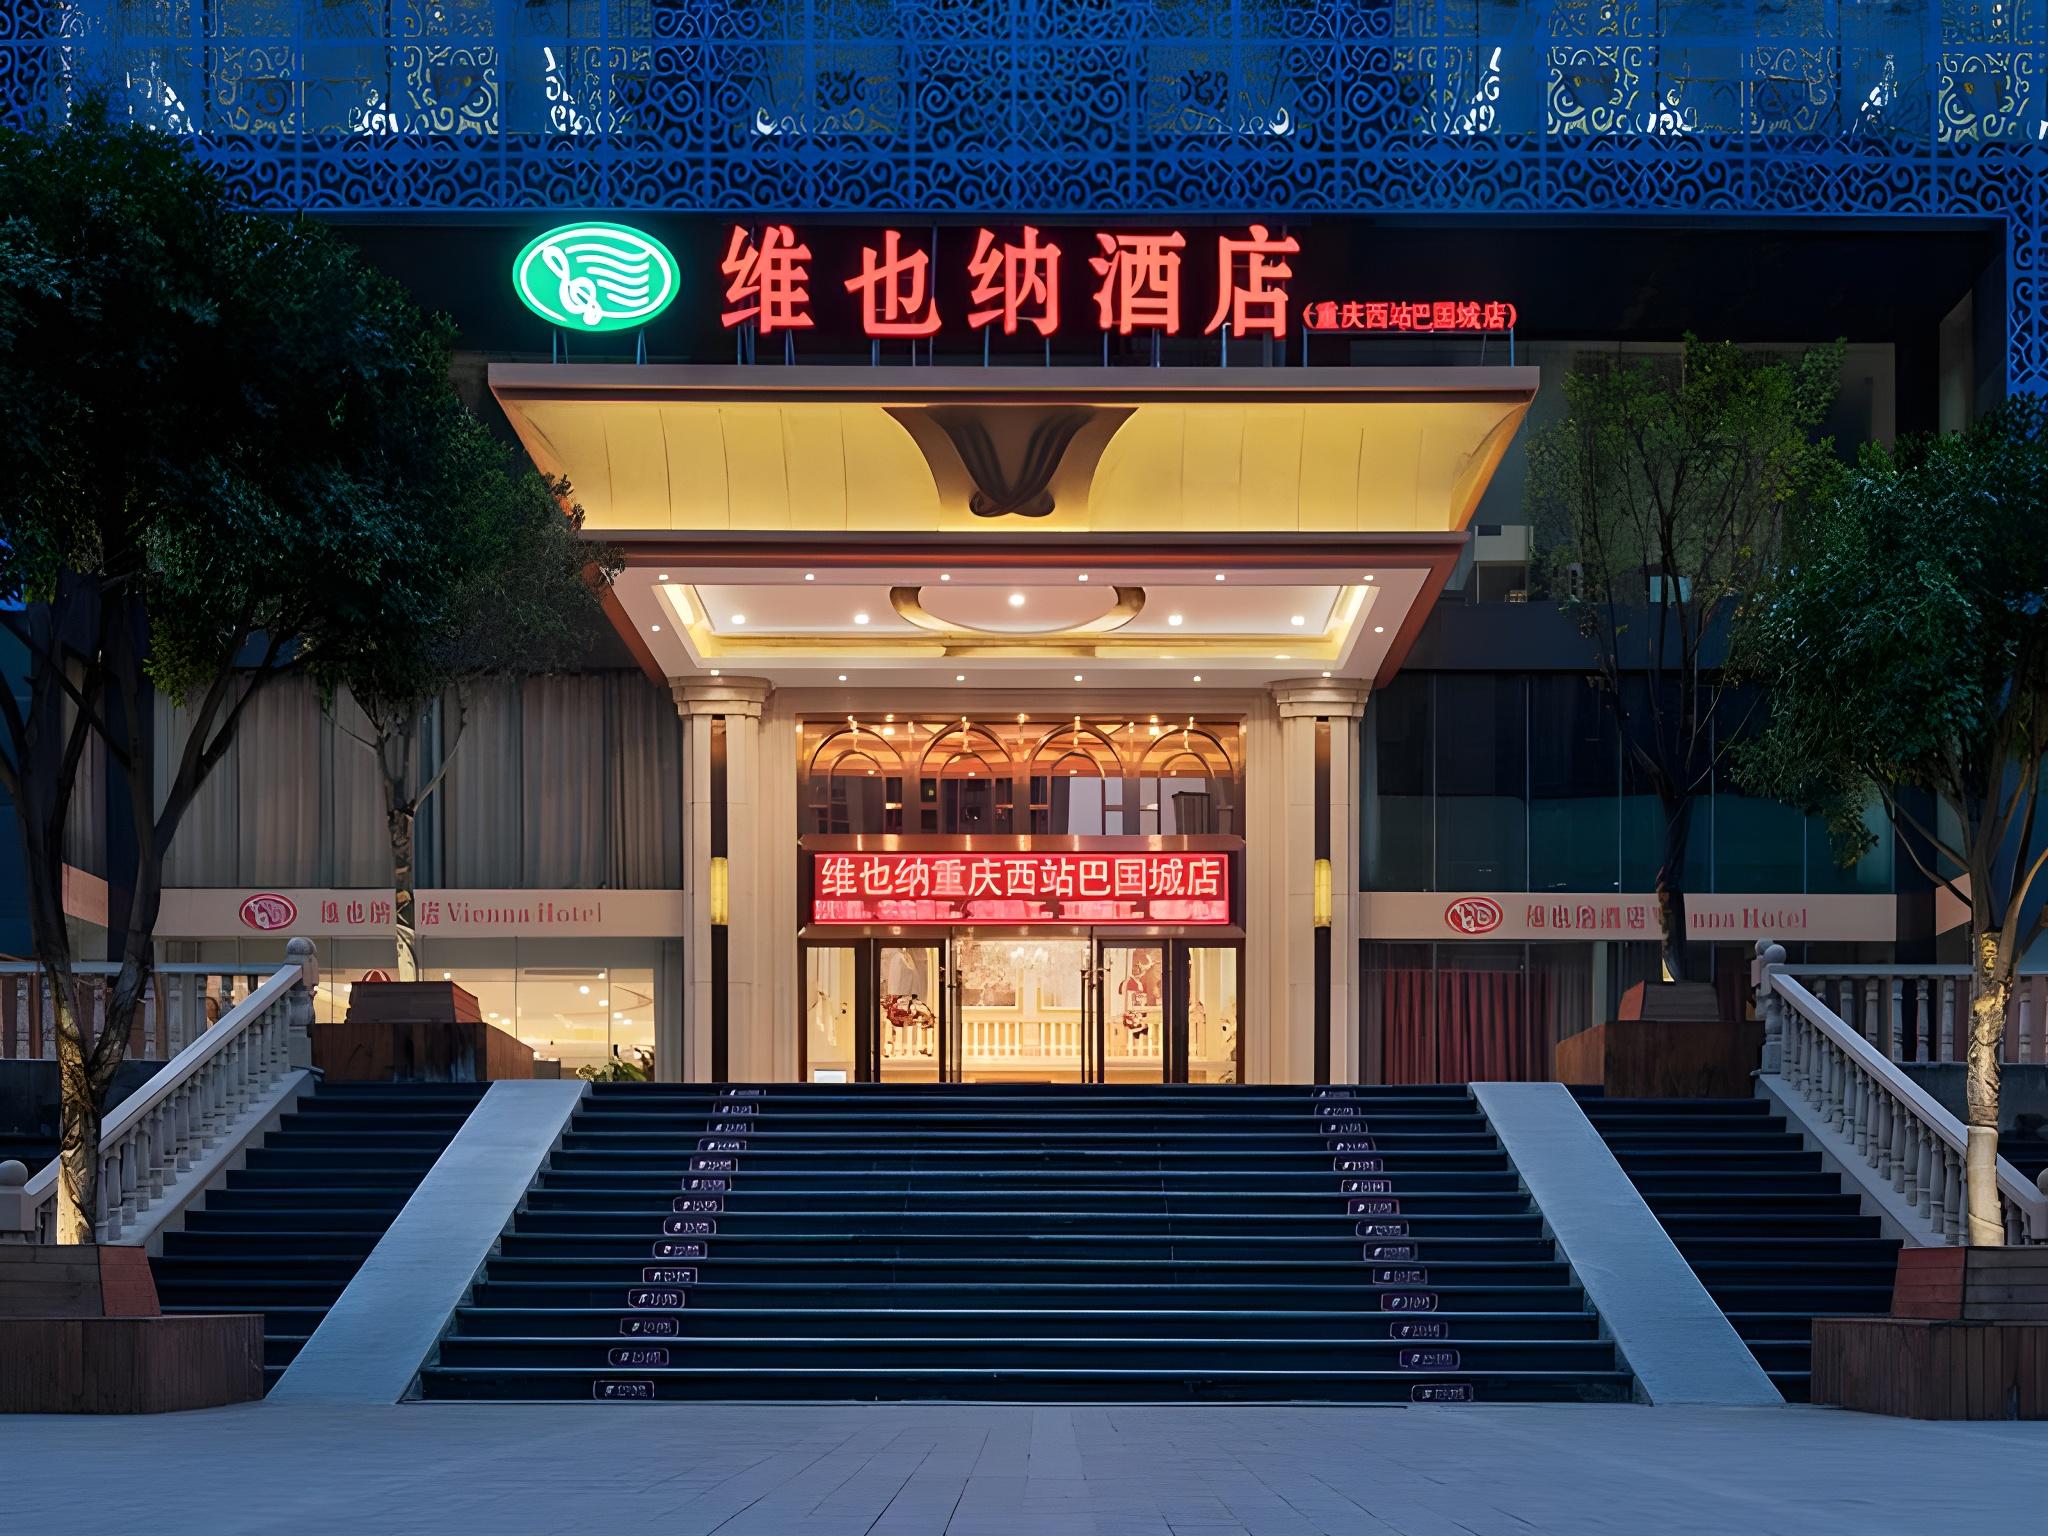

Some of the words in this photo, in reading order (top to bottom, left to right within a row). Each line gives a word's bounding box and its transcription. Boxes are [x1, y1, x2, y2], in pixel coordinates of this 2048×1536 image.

[721, 225, 1299, 336] 维也纳酒店
[822, 857, 1220, 897] 维也纳重庆西站巴国城店
